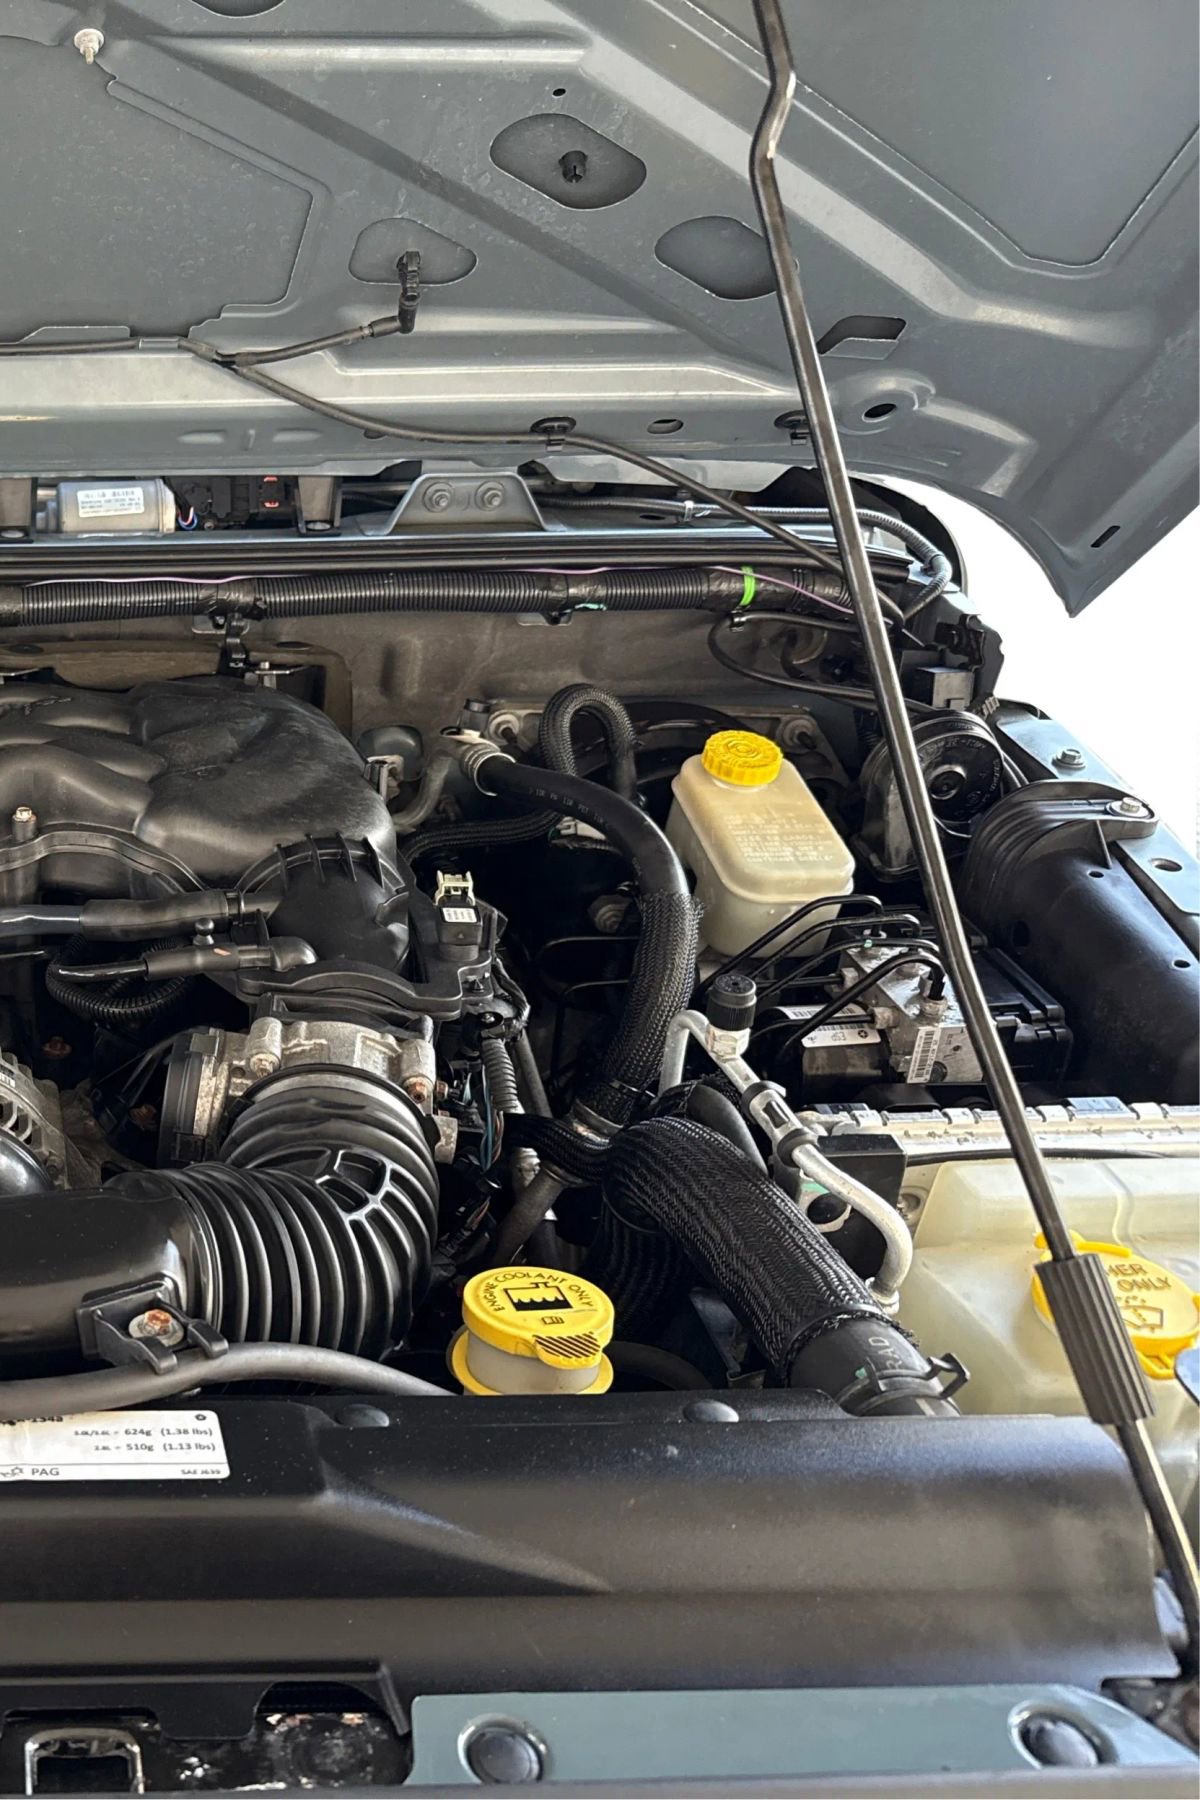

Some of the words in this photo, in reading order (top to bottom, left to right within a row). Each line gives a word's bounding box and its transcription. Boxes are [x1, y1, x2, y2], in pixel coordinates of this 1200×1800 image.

[494, 1271, 568, 1284] COOLANT
[1117, 1277, 1172, 1292] ONLY
[483, 1281, 506, 1312] ENGINE
[569, 1284, 594, 1308] ONLY
[124, 1428, 152, 1437] 624g
[160, 1427, 189, 1437] (1.38
[192, 1427, 213, 1437] lbs)
[126, 1443, 154, 1452] 510g
[163, 1442, 192, 1452] (1.13
[195, 1442, 216, 1452] lbs)
[31, 1467, 60, 1476] PAG
